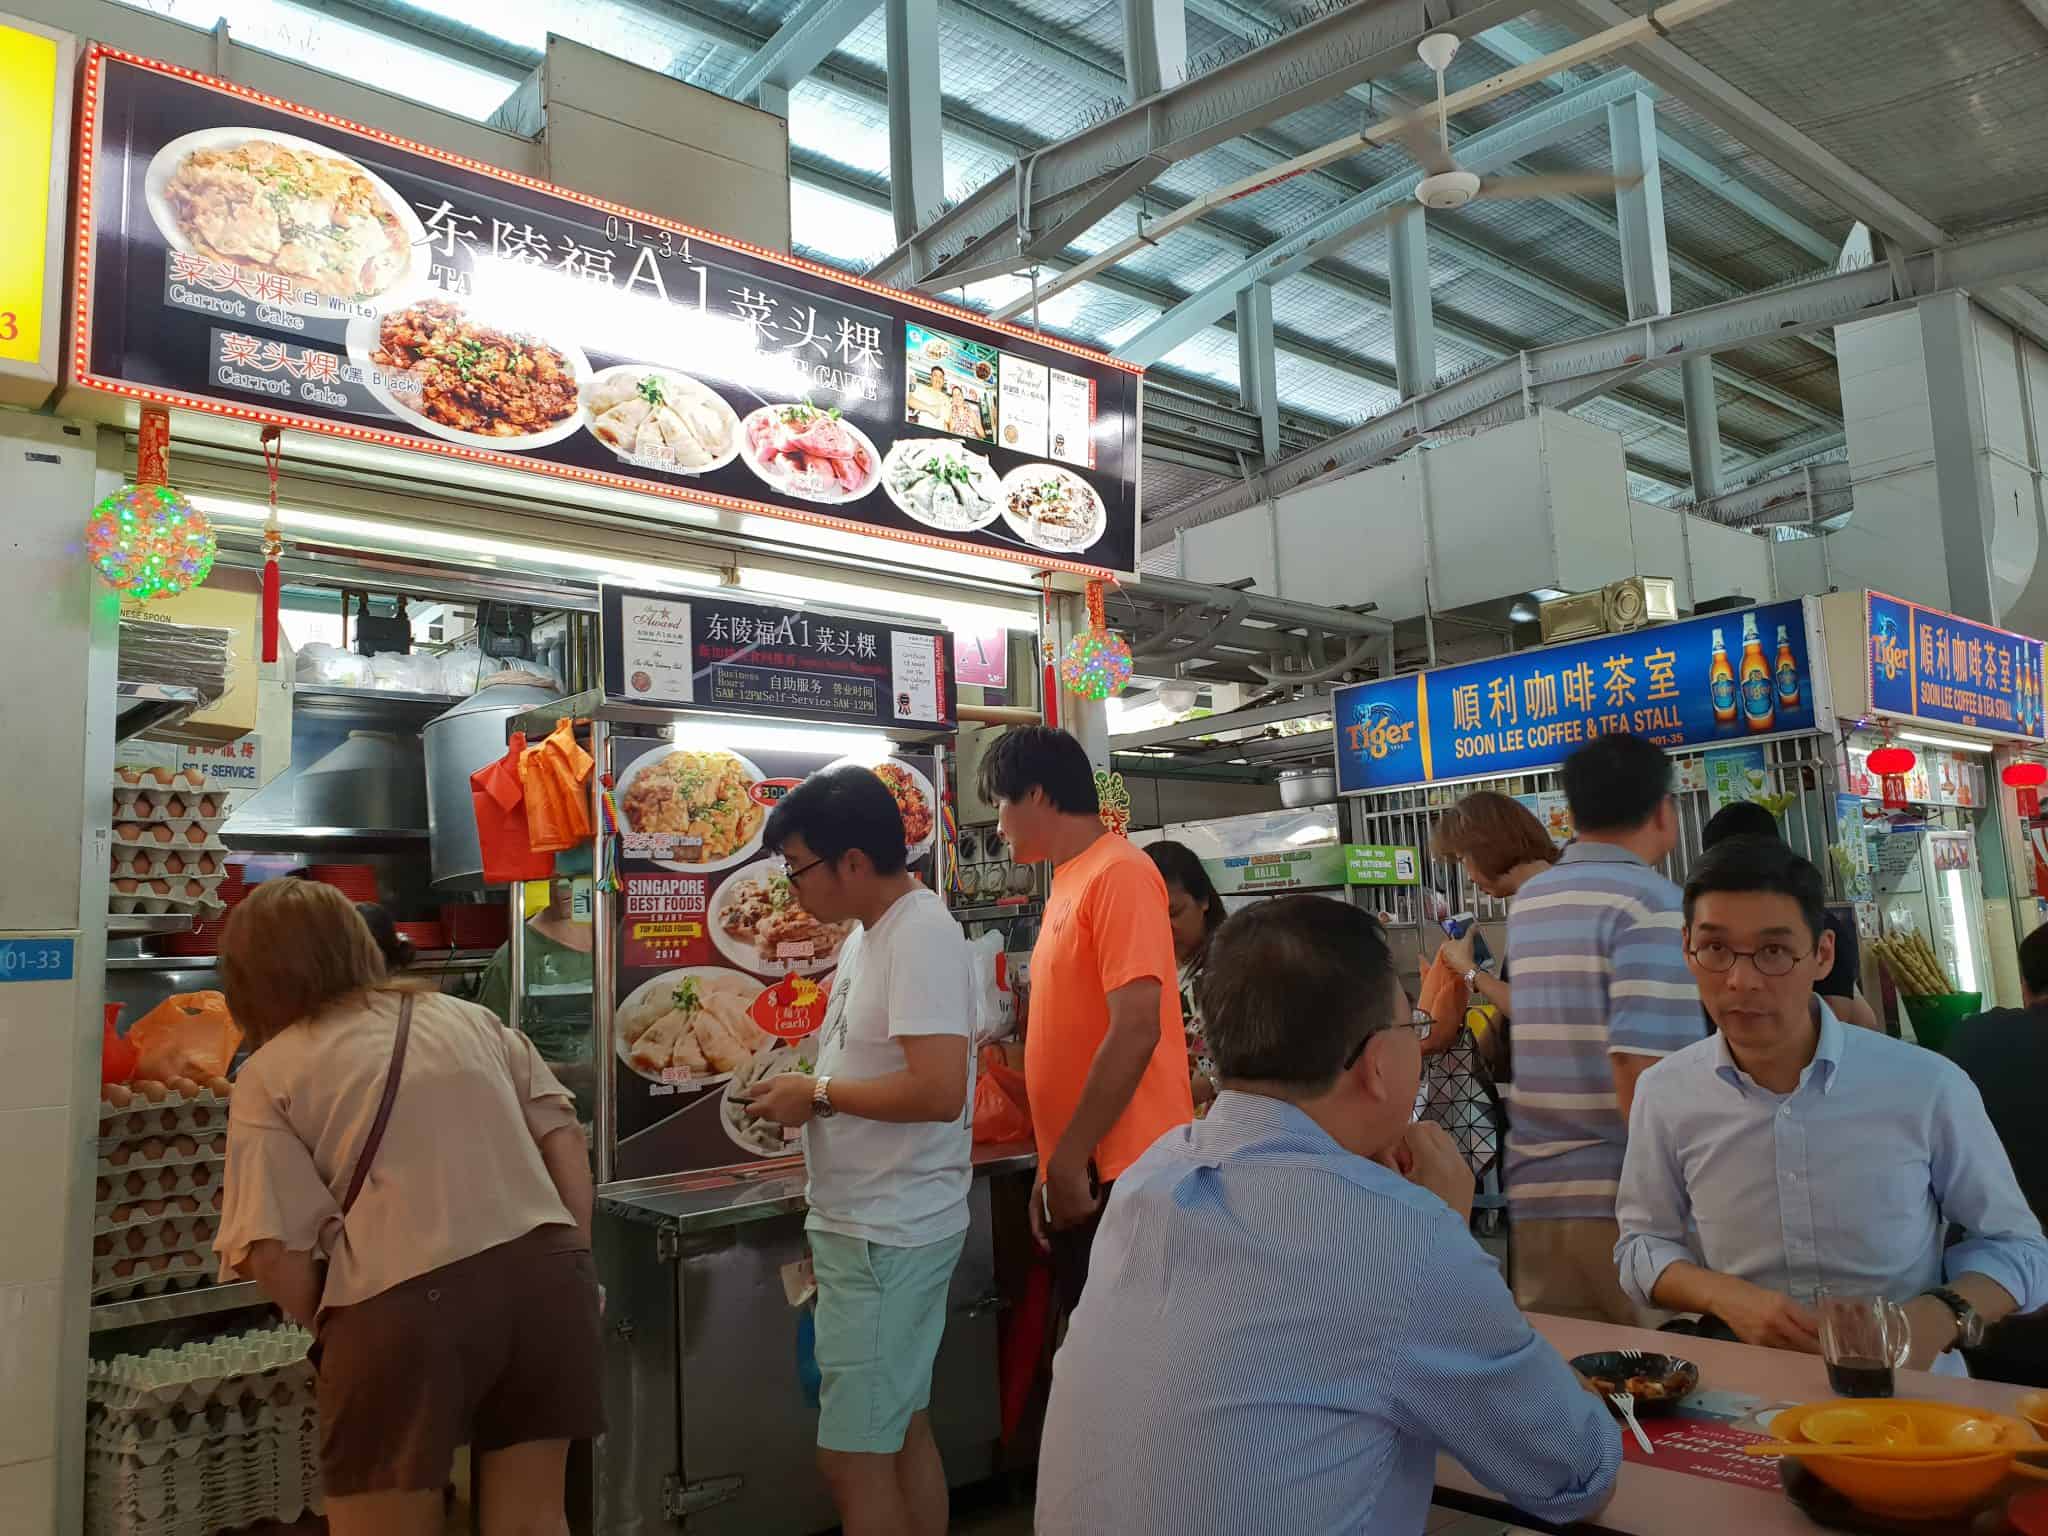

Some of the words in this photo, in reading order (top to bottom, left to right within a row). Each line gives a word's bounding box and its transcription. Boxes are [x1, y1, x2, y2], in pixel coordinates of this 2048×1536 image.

[605, 215, 693, 264] 01-34
[168, 250, 299, 306] 菜头粿
[170, 285, 247, 317] Carrot
[256, 304, 305, 330] Cake
[219, 332, 340, 384] 菜头粿
[217, 366, 291, 396] Carrot
[300, 383, 348, 408] Cake
[144, 612, 171, 623] SPOON
[1872, 633, 1909, 680] Tiger
[1920, 624, 2012, 693] 順利咖啡茶室
[770, 675, 823, 695] 自助服务
[1452, 647, 1680, 730] 順利咖啡茶室
[1345, 716, 1415, 758] Tiger
[1455, 732, 1495, 759] SOON
[1499, 729, 1524, 753] LEE
[1528, 720, 1582, 748] COFFEE
[1586, 718, 1598, 739] &
[1599, 714, 1630, 735] TEA
[1634, 705, 1683, 733] STALL
[211, 765, 255, 778] SERVICE
[628, 879, 705, 896] SINGAPORE
[630, 897, 662, 911] BEST
[664, 897, 703, 911] FOODS
[5, 950, 61, 969] 01-33
